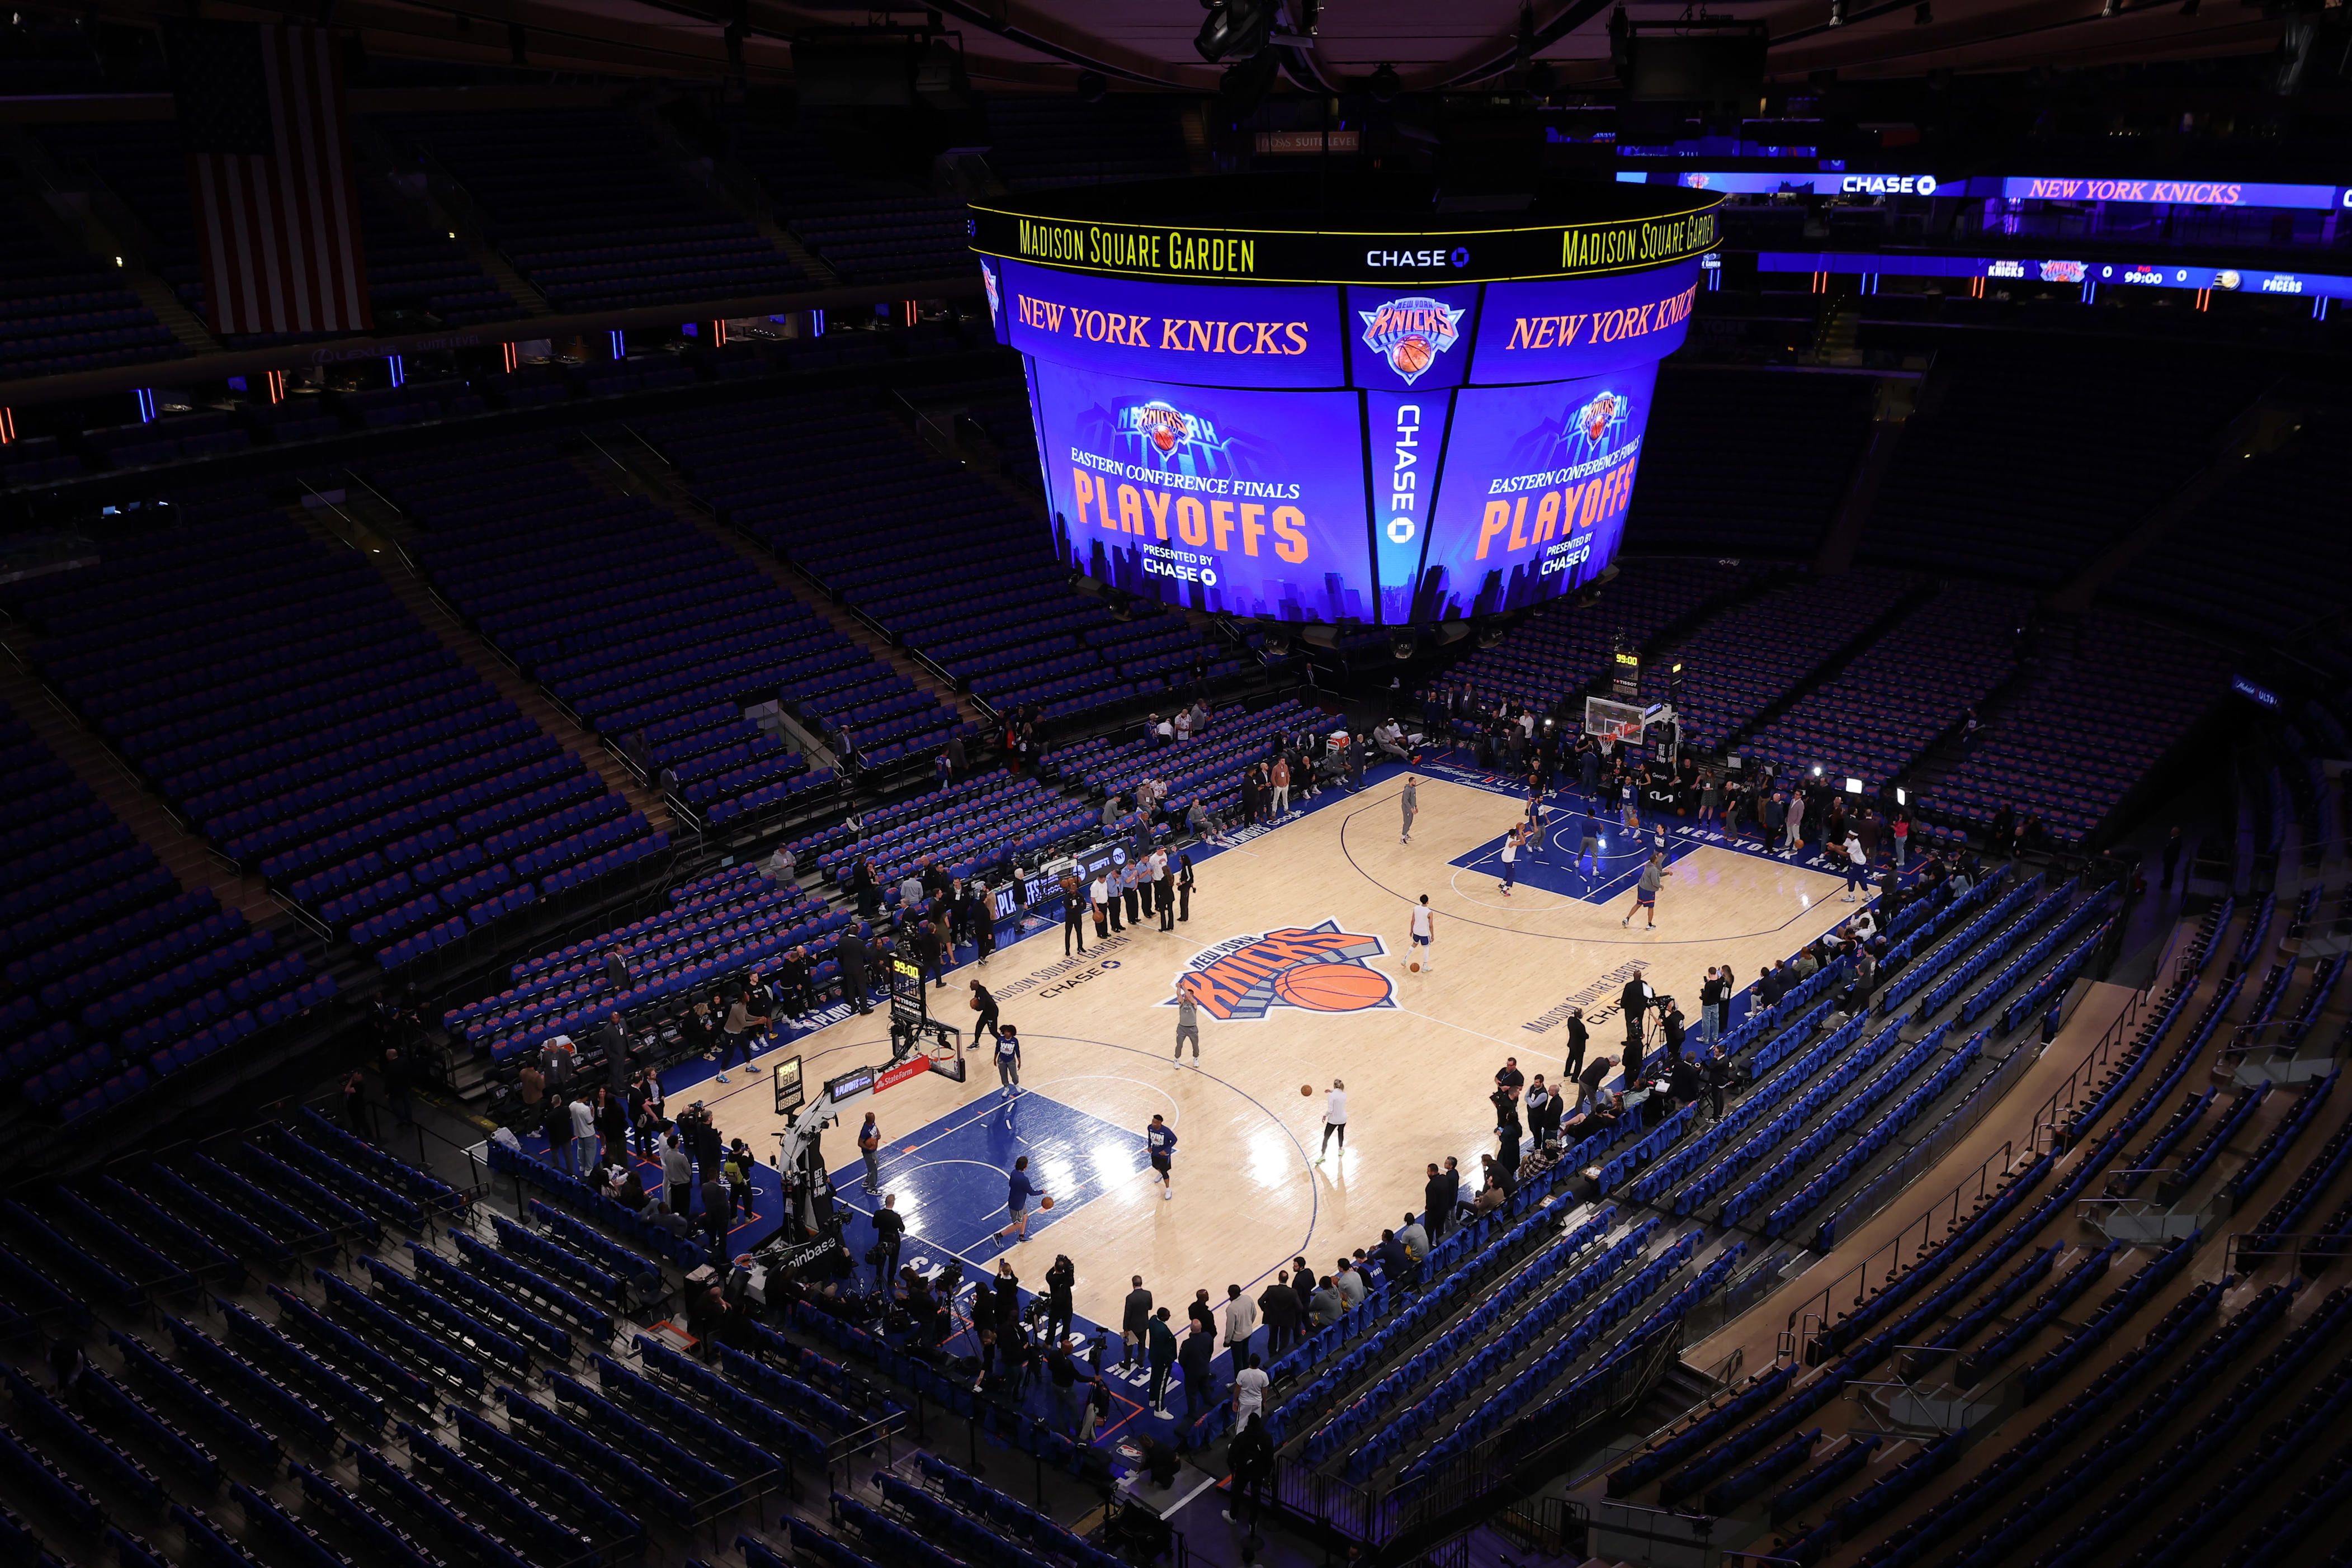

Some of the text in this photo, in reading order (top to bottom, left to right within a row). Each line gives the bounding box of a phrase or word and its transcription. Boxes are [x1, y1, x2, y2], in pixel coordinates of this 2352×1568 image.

[1296, 138, 1324, 147] SUITE
[1328, 136, 1357, 146] LEVEL
[1842, 176, 1913, 193] CHASE
[2028, 179, 2241, 204] NEW YORK KNICKS
[1367, 251, 1446, 267] CHASE
[2044, 261, 2082, 277] KNICKS
[1988, 265, 2024, 277] KNICKS
[2102, 266, 2113, 278] 0
[2124, 272, 2162, 284] 99:00
[2176, 270, 2187, 282] 0
[2263, 279, 2303, 294] PACERS
[1415, 300, 1433, 308] YORK
[1018, 294, 1309, 355] NEW YORK KNICKS
[1368, 307, 1455, 339] KNICKS
[1505, 313, 1588, 350] NEW
[1588, 304, 1655, 344] YORK
[336, 334, 481, 361] LEXUS SUITE LEVEL
[1139, 407, 1189, 434] KNICKS
[1585, 396, 1614, 423] KNICKS
[1392, 404, 1421, 512] CHASE
[1489, 434, 1641, 494] EASTERN CONFERENCE FINALS
[1071, 447, 1300, 500] EASTERN CONFERENCE FINALS
[1073, 467, 1309, 564] PLAYOFFS
[1475, 456, 1635, 560] PLAYOFFS
[1143, 543, 1213, 566] PRESENTED BY
[1546, 531, 1593, 558] PRESENTED BY
[1143, 558, 1199, 583] CHASE
[1541, 550, 1580, 576] CHASE
[1616, 654, 1637, 665] 99:00
[1496, 780, 1559, 799] ULTA
[1267, 810, 1305, 825] Google
[1225, 824, 1272, 846] PLAYOFFS
[1675, 826, 1725, 842] NEW
[1733, 839, 1798, 860] YOK
[1089, 857, 1110, 873] ESPN
[1113, 852, 1125, 862] TNT
[997, 878, 1042, 917] PLAFFS
[1189, 935, 1260, 970] NEW YORK
[894, 960, 918, 978] 99:00
[990, 977, 1040, 1004] ADISON
[1031, 956, 1087, 980] SQUARE
[1179, 927, 1377, 1019] KNICKS
[1040, 967, 1106, 998] CHASE
[1566, 980, 1616, 1006] SQUARE
[1601, 958, 1651, 984] GARDEN
[900, 998, 920, 1009] TISSOT
[1586, 998, 1622, 1025] CHA
[785, 1084, 802, 1095] TISSOT
[839, 1079, 859, 1095] PLAYOFFS
[859, 1078, 871, 1086] Google
[1150, 1131, 1164, 1141] WIN
[814, 1168, 823, 1179] GET
[815, 1177, 824, 1188] THE
[818, 1186, 826, 1197] App
